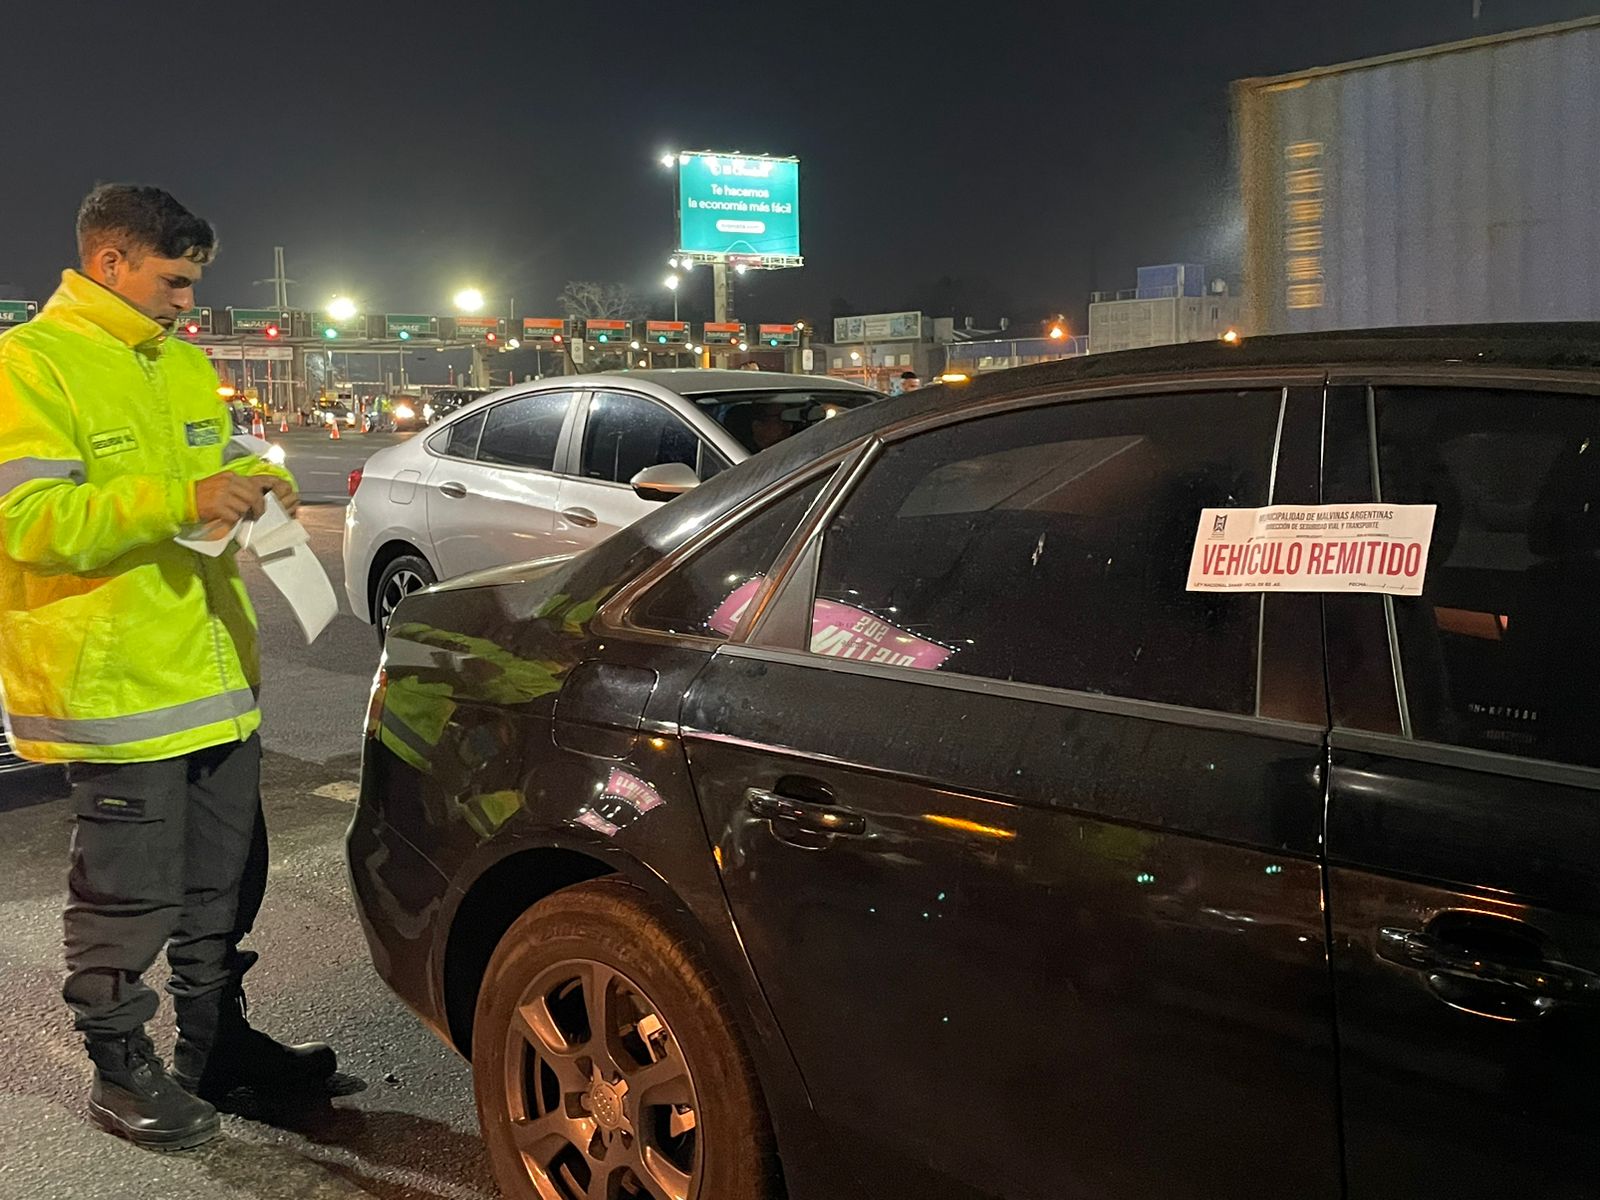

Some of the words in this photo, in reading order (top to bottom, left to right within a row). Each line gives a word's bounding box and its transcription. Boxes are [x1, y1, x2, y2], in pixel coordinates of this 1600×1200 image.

[711, 184, 723, 196] Te
[724, 185, 770, 198] hacemos
[688, 197, 698, 208] la
[699, 199, 747, 211] economía
[749, 201, 770, 213] más
[771, 201, 792, 214] fácil
[1306, 512, 1316, 521] DE
[1316, 511, 1349, 521] MALVINAS
[1349, 510, 1394, 520] ARGENTINAS
[1327, 521, 1340, 530] VIAL
[1340, 521, 1345, 530] Y
[1345, 521, 1380, 530] TRANSPORTE
[1202, 537, 1303, 577] VEHÍCULO
[1307, 541, 1422, 578] REMITIDO
